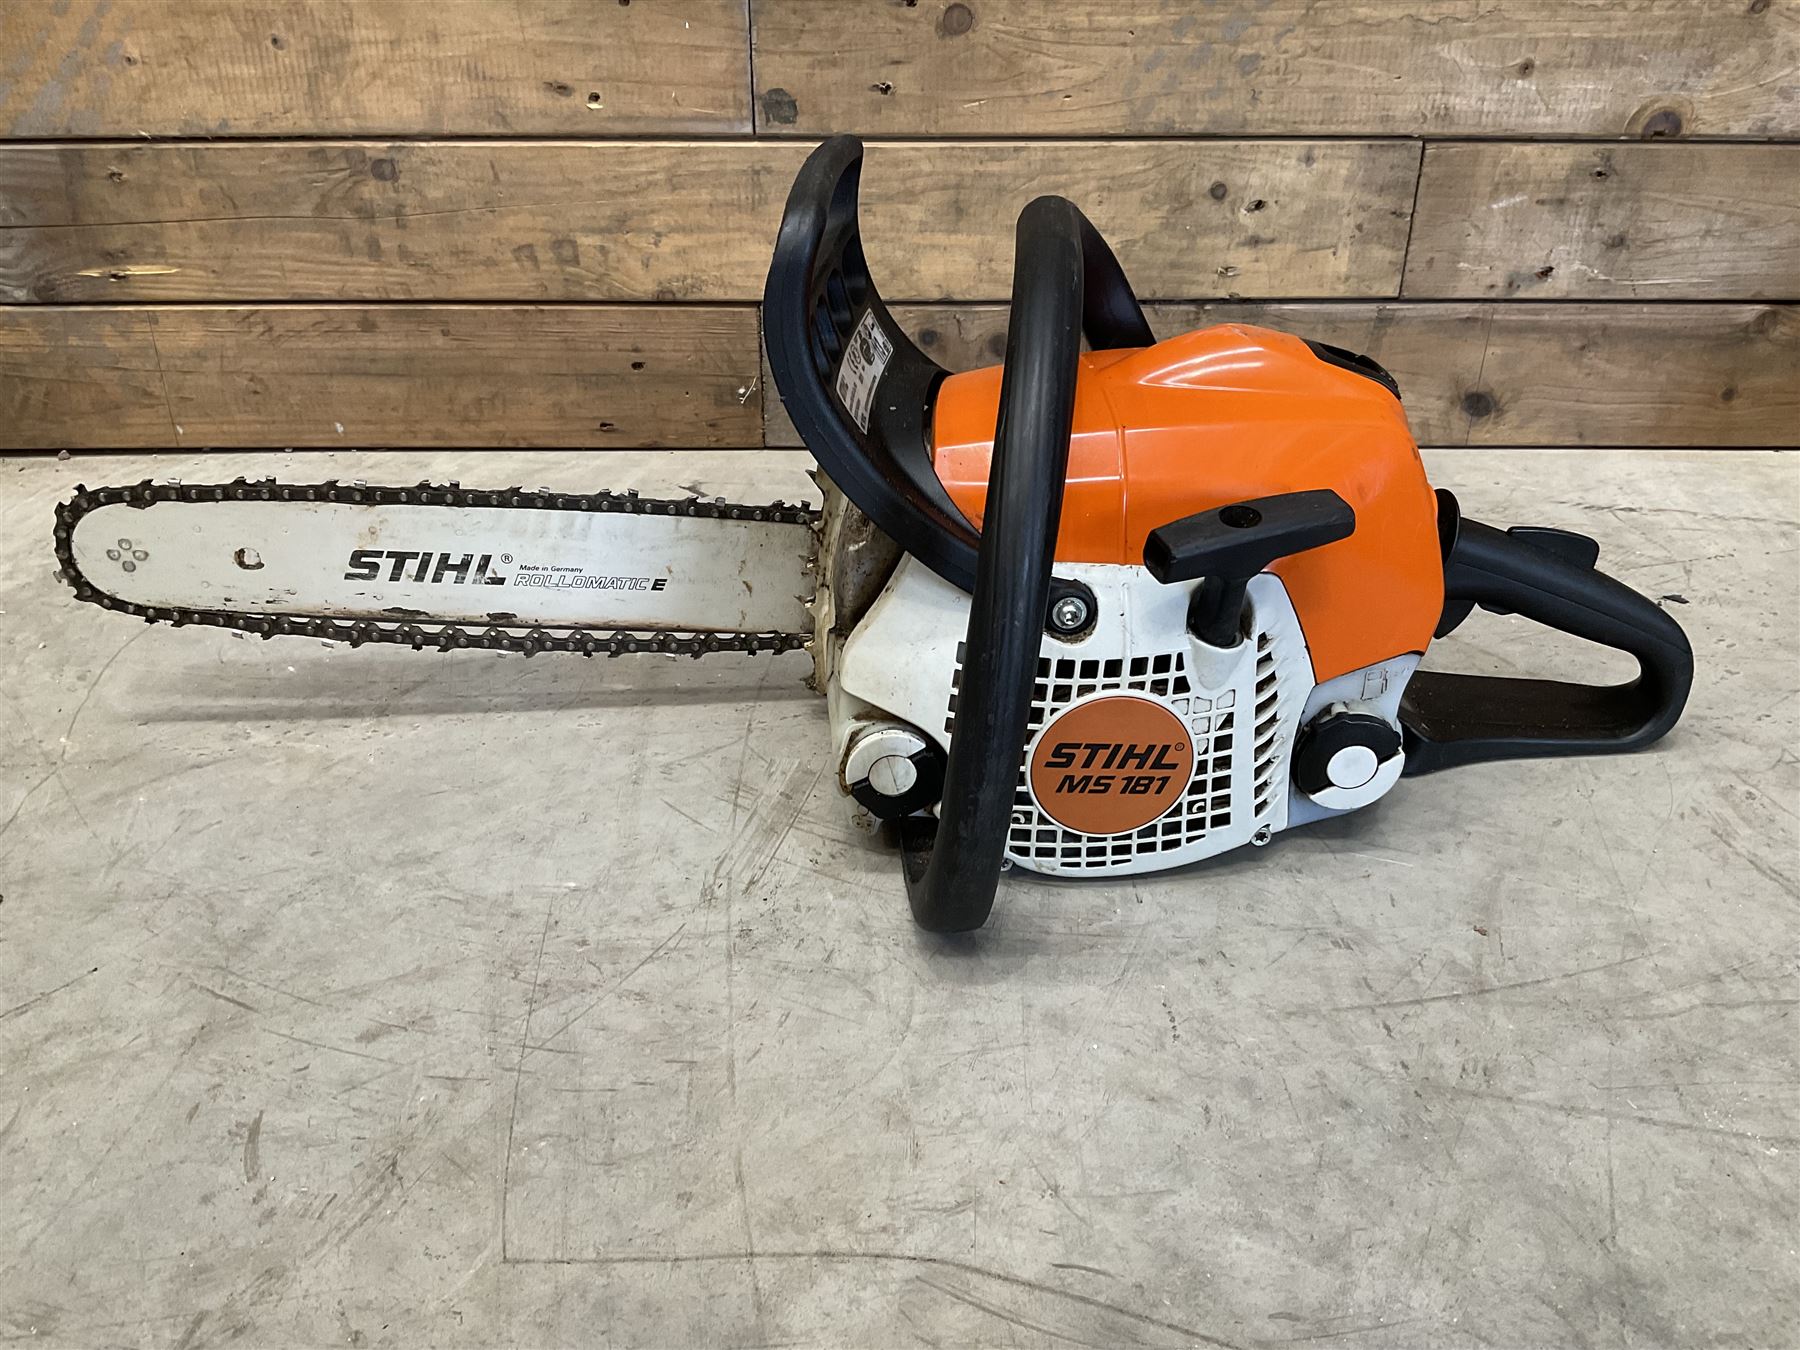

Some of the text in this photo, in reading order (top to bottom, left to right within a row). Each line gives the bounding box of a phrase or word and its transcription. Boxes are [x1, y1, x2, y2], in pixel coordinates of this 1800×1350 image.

[519, 564, 584, 575] Made in Germany
[513, 573, 668, 592] ROLLOMATIC E
[1044, 742, 1179, 770] STIHL
[1055, 774, 1171, 795] MS 181
